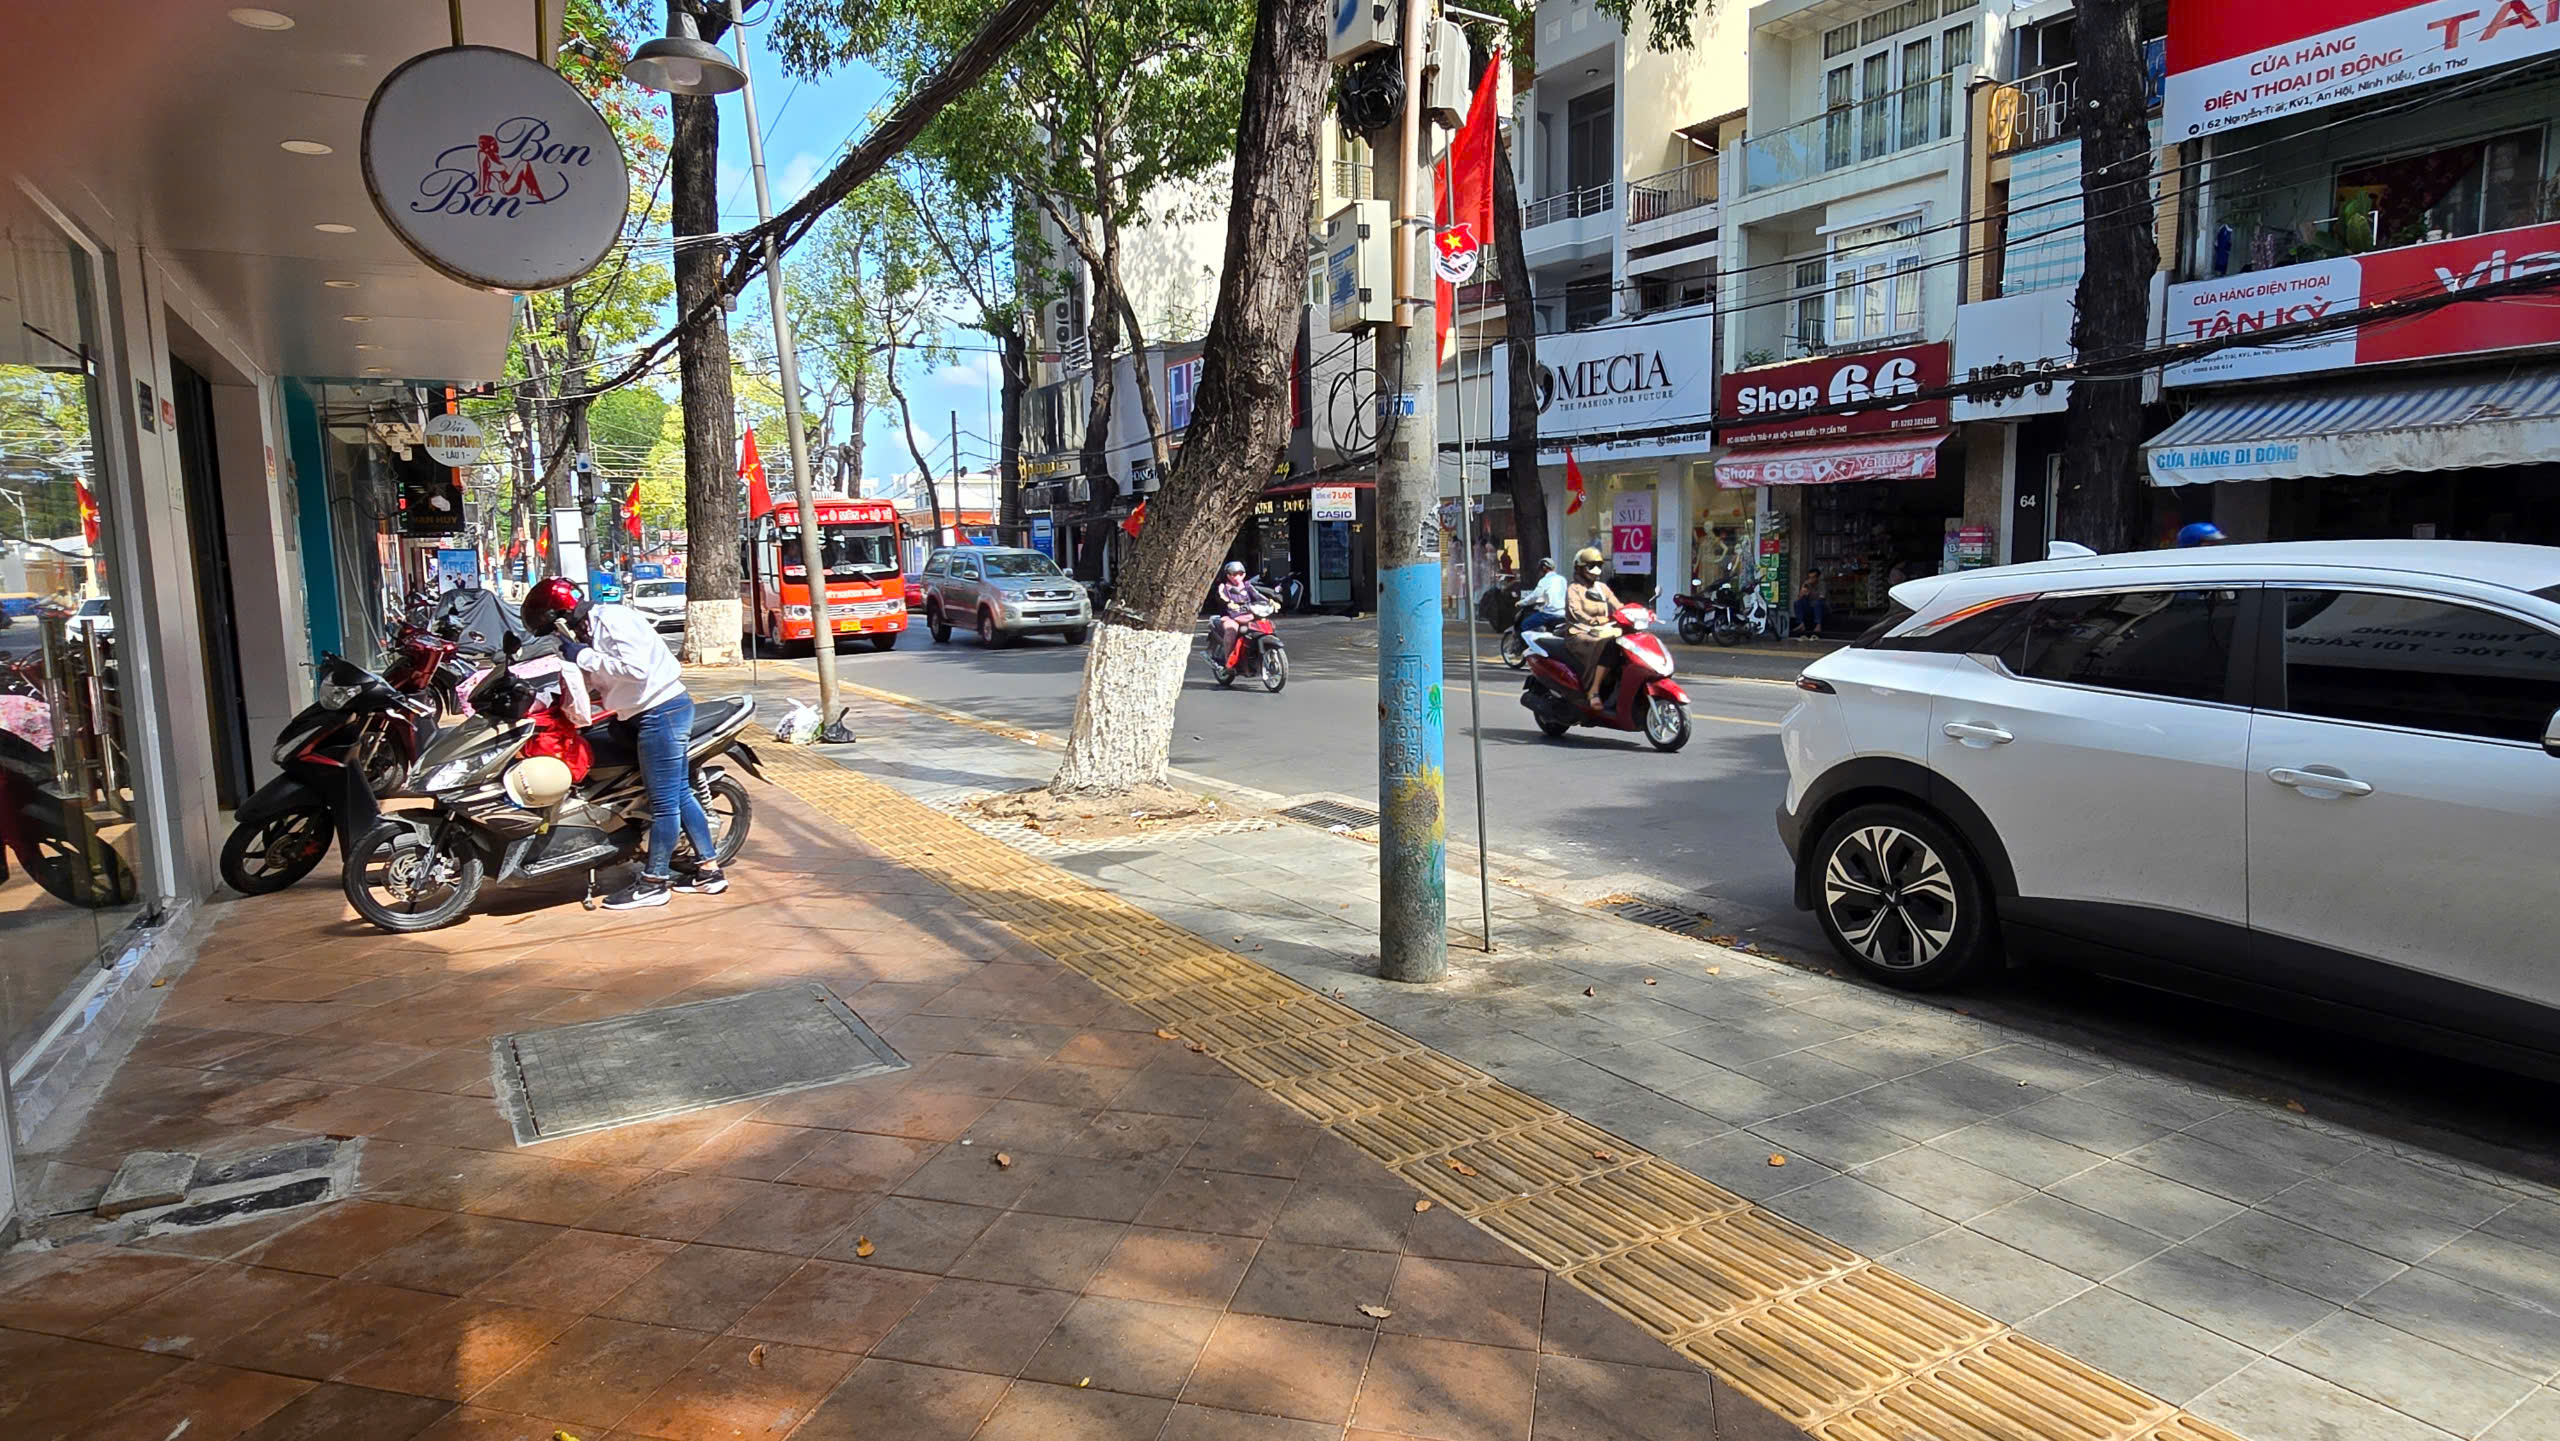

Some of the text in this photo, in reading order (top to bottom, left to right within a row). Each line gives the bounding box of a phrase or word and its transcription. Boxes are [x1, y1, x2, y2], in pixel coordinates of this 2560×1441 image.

[2251, 36, 2356, 76] CỬA HÀNG
[2204, 49, 2403, 112] ĐIỆN THOẠI DI ĐỘNG
[2207, 118, 2221, 129] 62
[2316, 92, 2332, 102] An
[2445, 57, 2469, 70] Thơ
[495, 116, 592, 167] Bon
[410, 168, 523, 219] Bon
[2193, 275, 2330, 306] CỬA HÀNG ĐIỆN THOẠI
[2188, 295, 2333, 339] TÂN KỲ
[1557, 349, 1673, 401] MECIA
[1737, 385, 1819, 415] Shop
[1828, 357, 1920, 416] 66
[1560, 390, 1673, 412] THE FASHION FOR FUTURE
[1722, 467, 1755, 481] Shop
[1763, 460, 1804, 481] 66
[2190, 448, 2230, 466] HÀNG
[2234, 449, 2250, 464] DI
[1317, 511, 1352, 519] CASIO
[1620, 508, 1646, 522] SALE
[2020, 495, 2036, 508] 64
